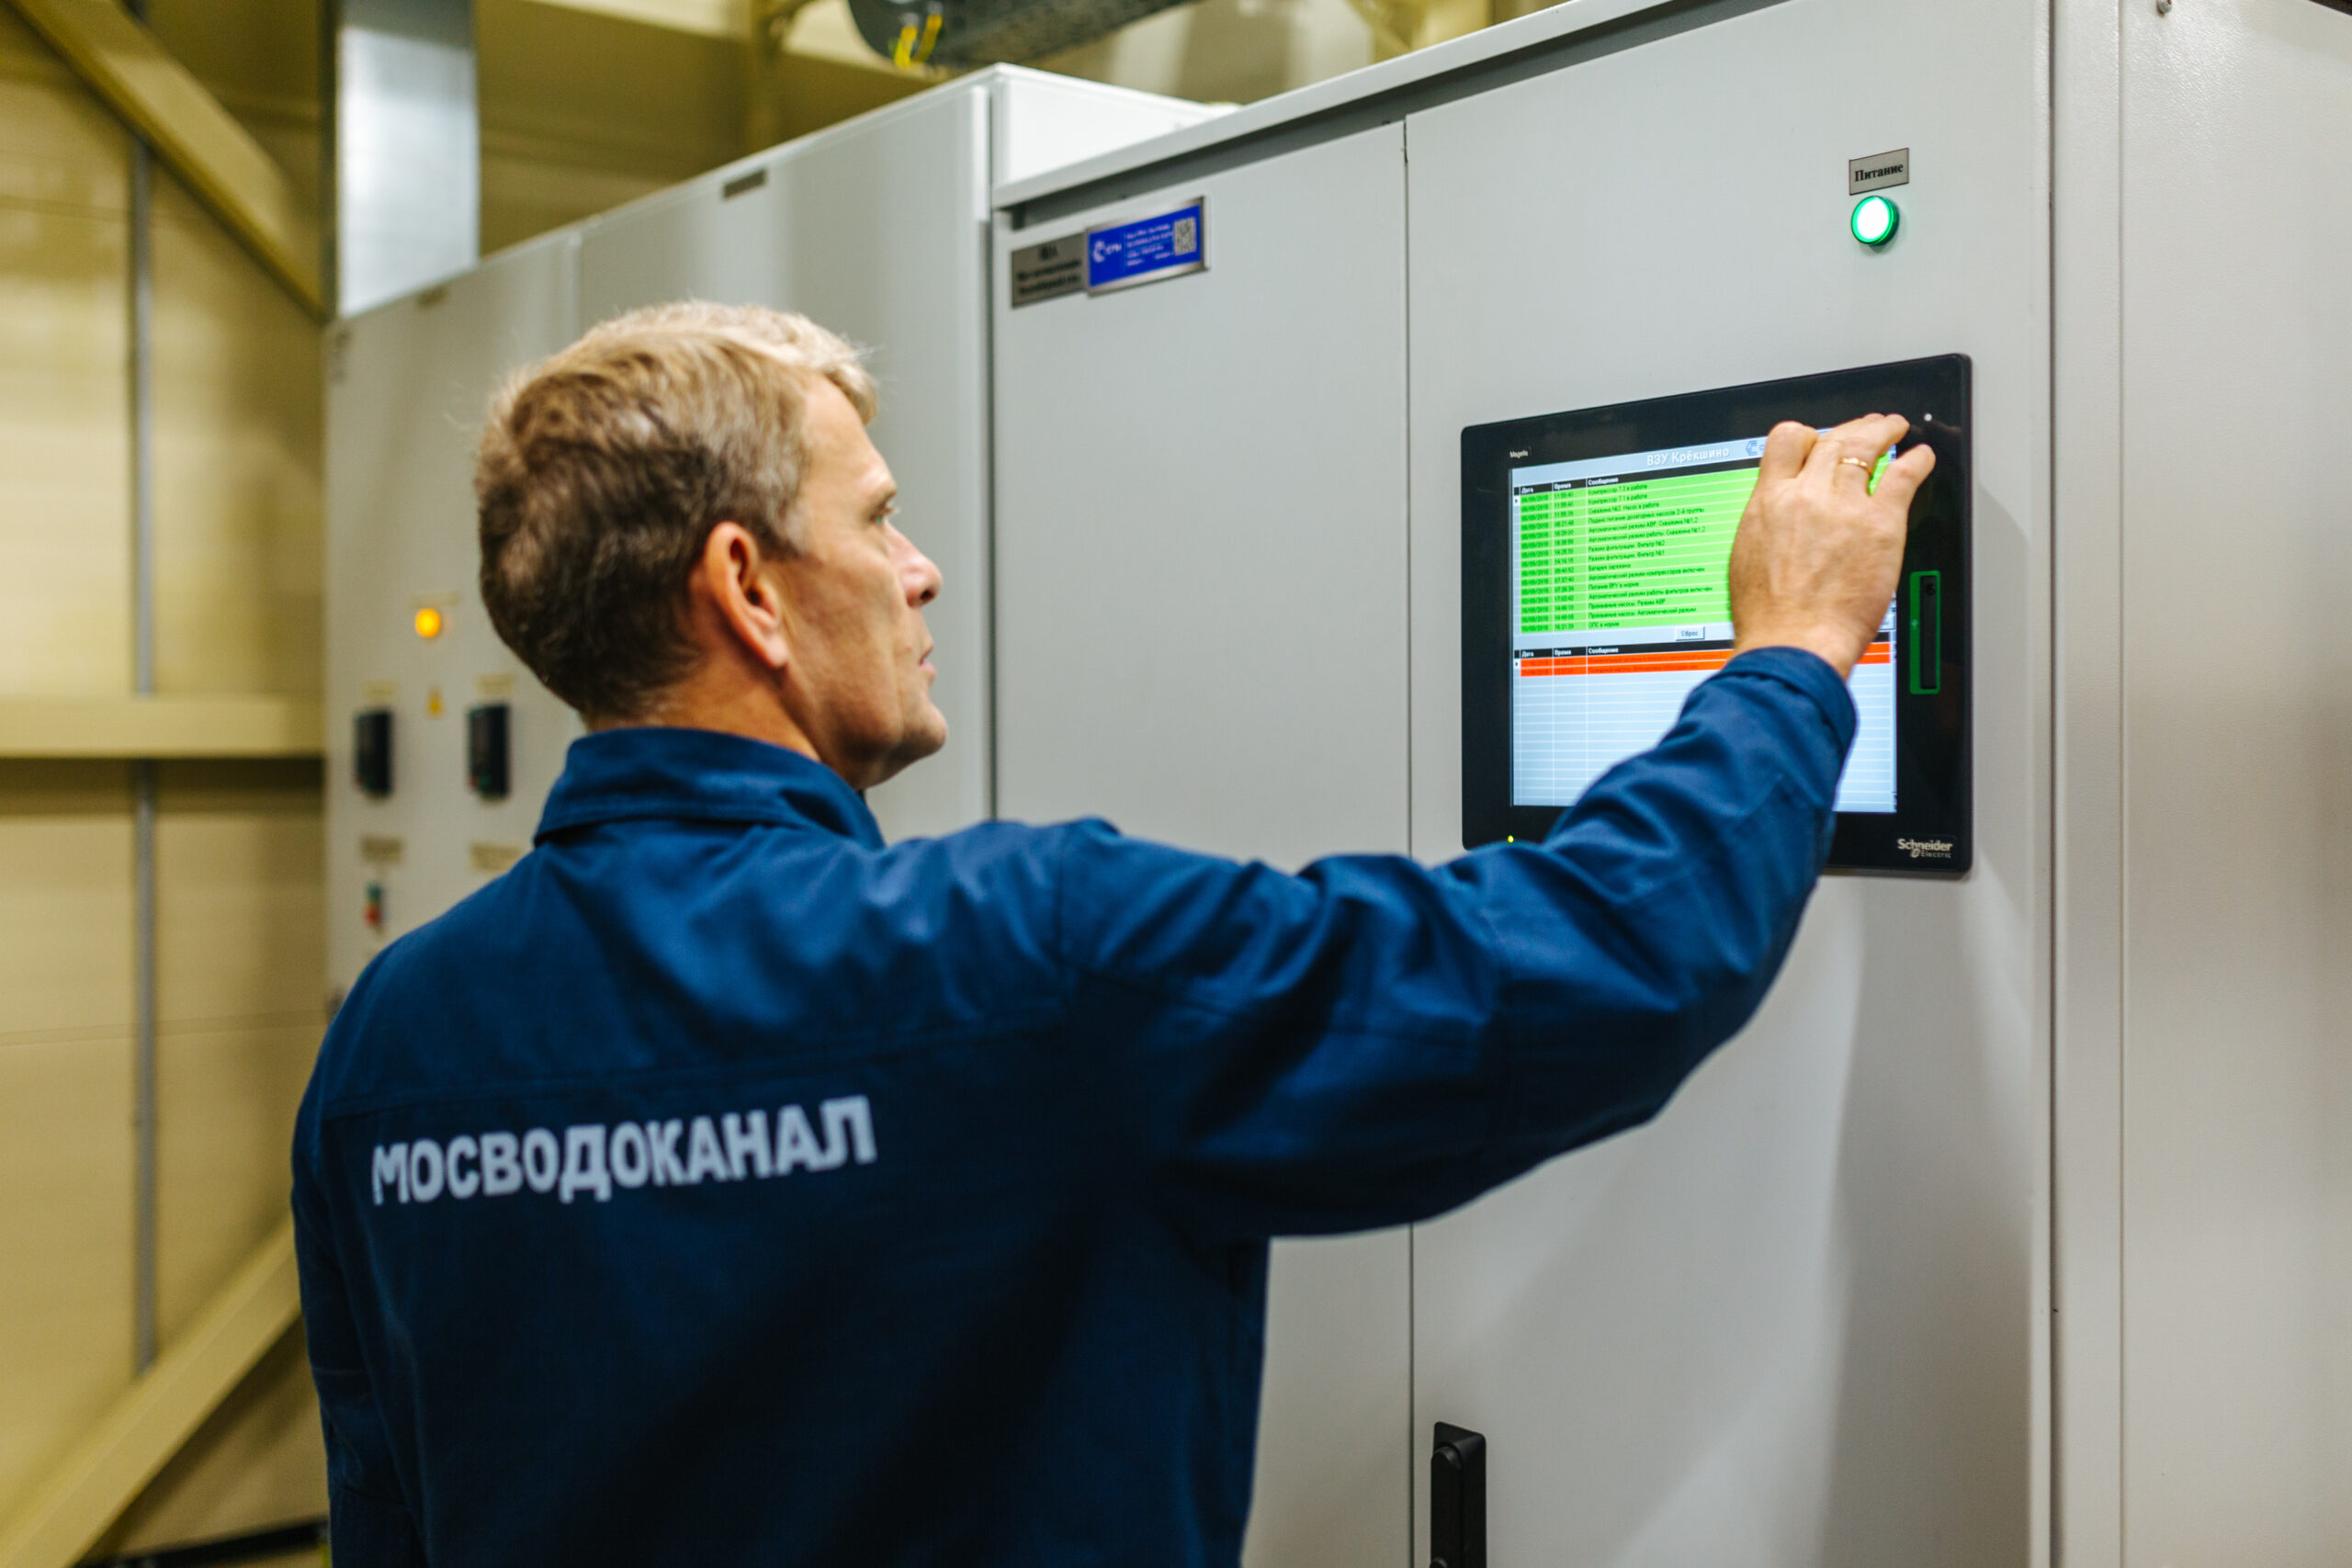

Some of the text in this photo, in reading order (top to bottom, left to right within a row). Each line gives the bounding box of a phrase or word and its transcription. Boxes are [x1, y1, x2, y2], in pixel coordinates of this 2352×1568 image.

[1855, 164, 1904, 182] Питание
[1646, 448, 1730, 466] ВЗУ Крёкшино
[1897, 839, 1953, 852] Schneider
[372, 1095, 877, 1205] МОСВОДОКАНАЛ
